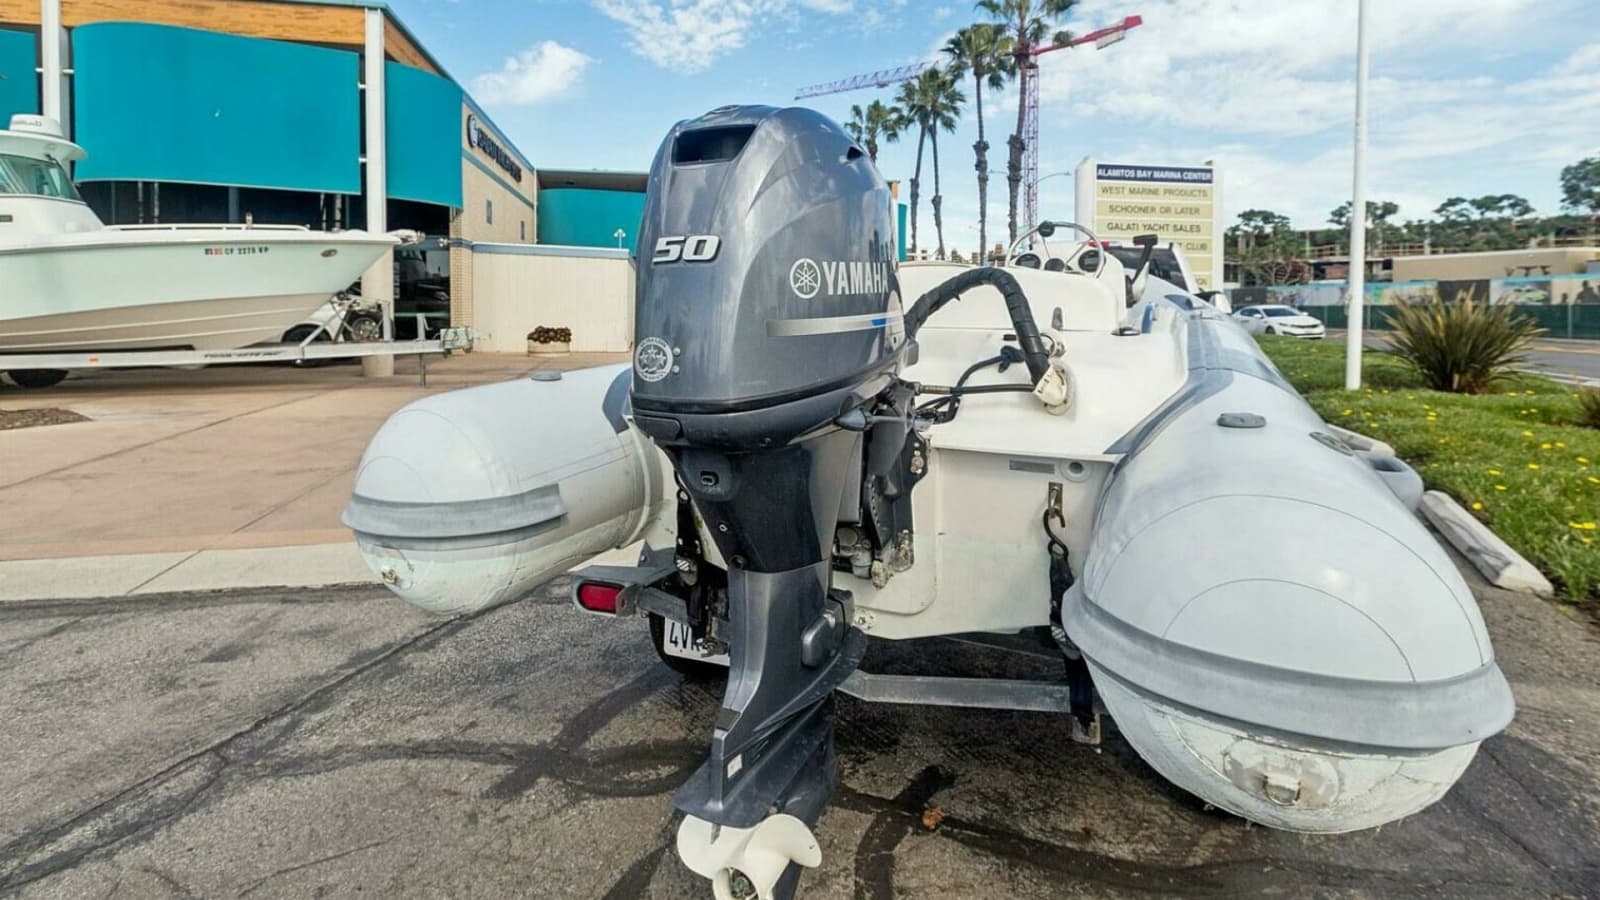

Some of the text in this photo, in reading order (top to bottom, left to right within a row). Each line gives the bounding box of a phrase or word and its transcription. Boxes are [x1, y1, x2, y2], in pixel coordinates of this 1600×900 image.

[1097, 168, 1212, 181] ALAMITOS BAY MARINA CENTER
[1101, 186, 1208, 198] WEST MARINE PRODUCTS
[1109, 204, 1201, 216] SCHOONER OR LATER
[1106, 222, 1201, 233] GALATI YACHT SALES
[652, 234, 721, 264] 50
[1185, 242, 1208, 251] CLUB
[822, 260, 889, 296] YAMAHA
